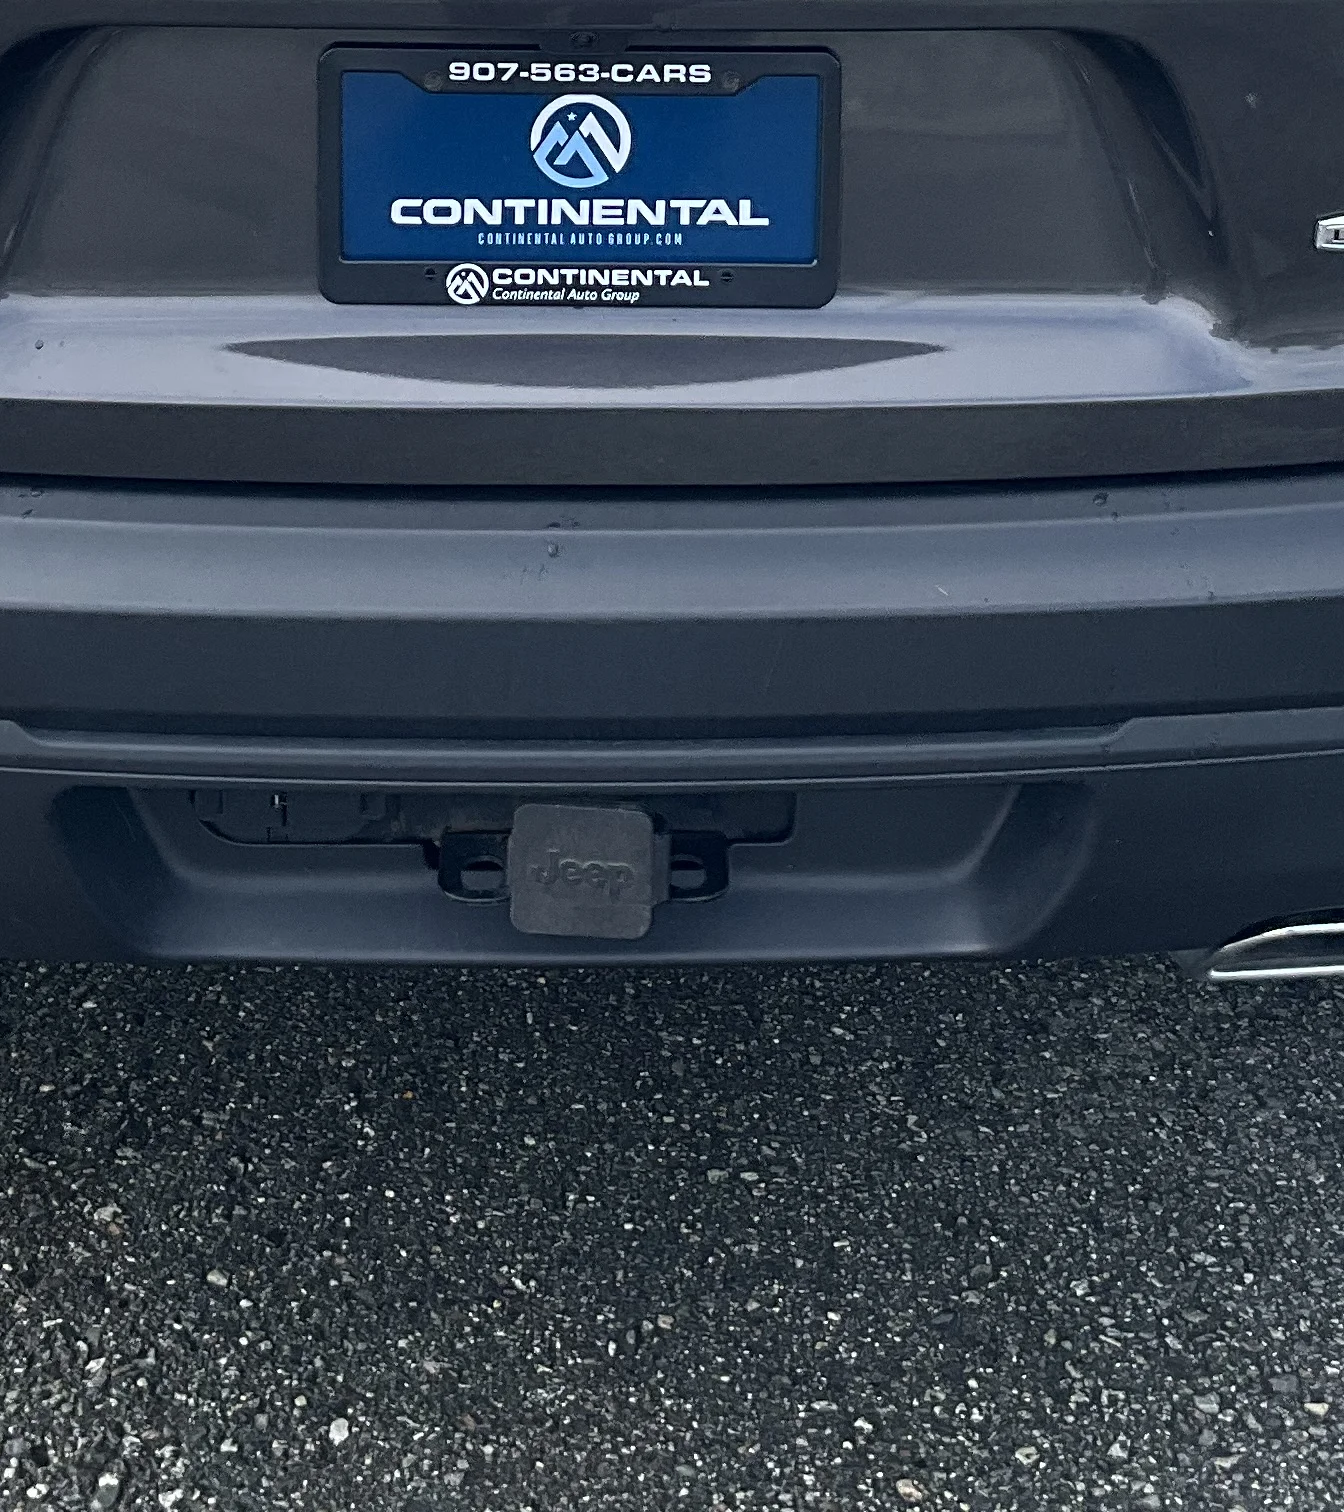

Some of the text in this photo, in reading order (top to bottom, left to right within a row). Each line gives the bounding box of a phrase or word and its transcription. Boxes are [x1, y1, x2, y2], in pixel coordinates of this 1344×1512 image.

[448, 61, 713, 84] 907-563-CARS
[390, 197, 770, 227] CONTINENTAL
[477, 232, 683, 245] CONTINENTAL AUTO GROUP.COM
[492, 268, 710, 287] CONTINENTAL
[492, 287, 640, 304] Continental Auto Group
[527, 849, 635, 904] Jeep
